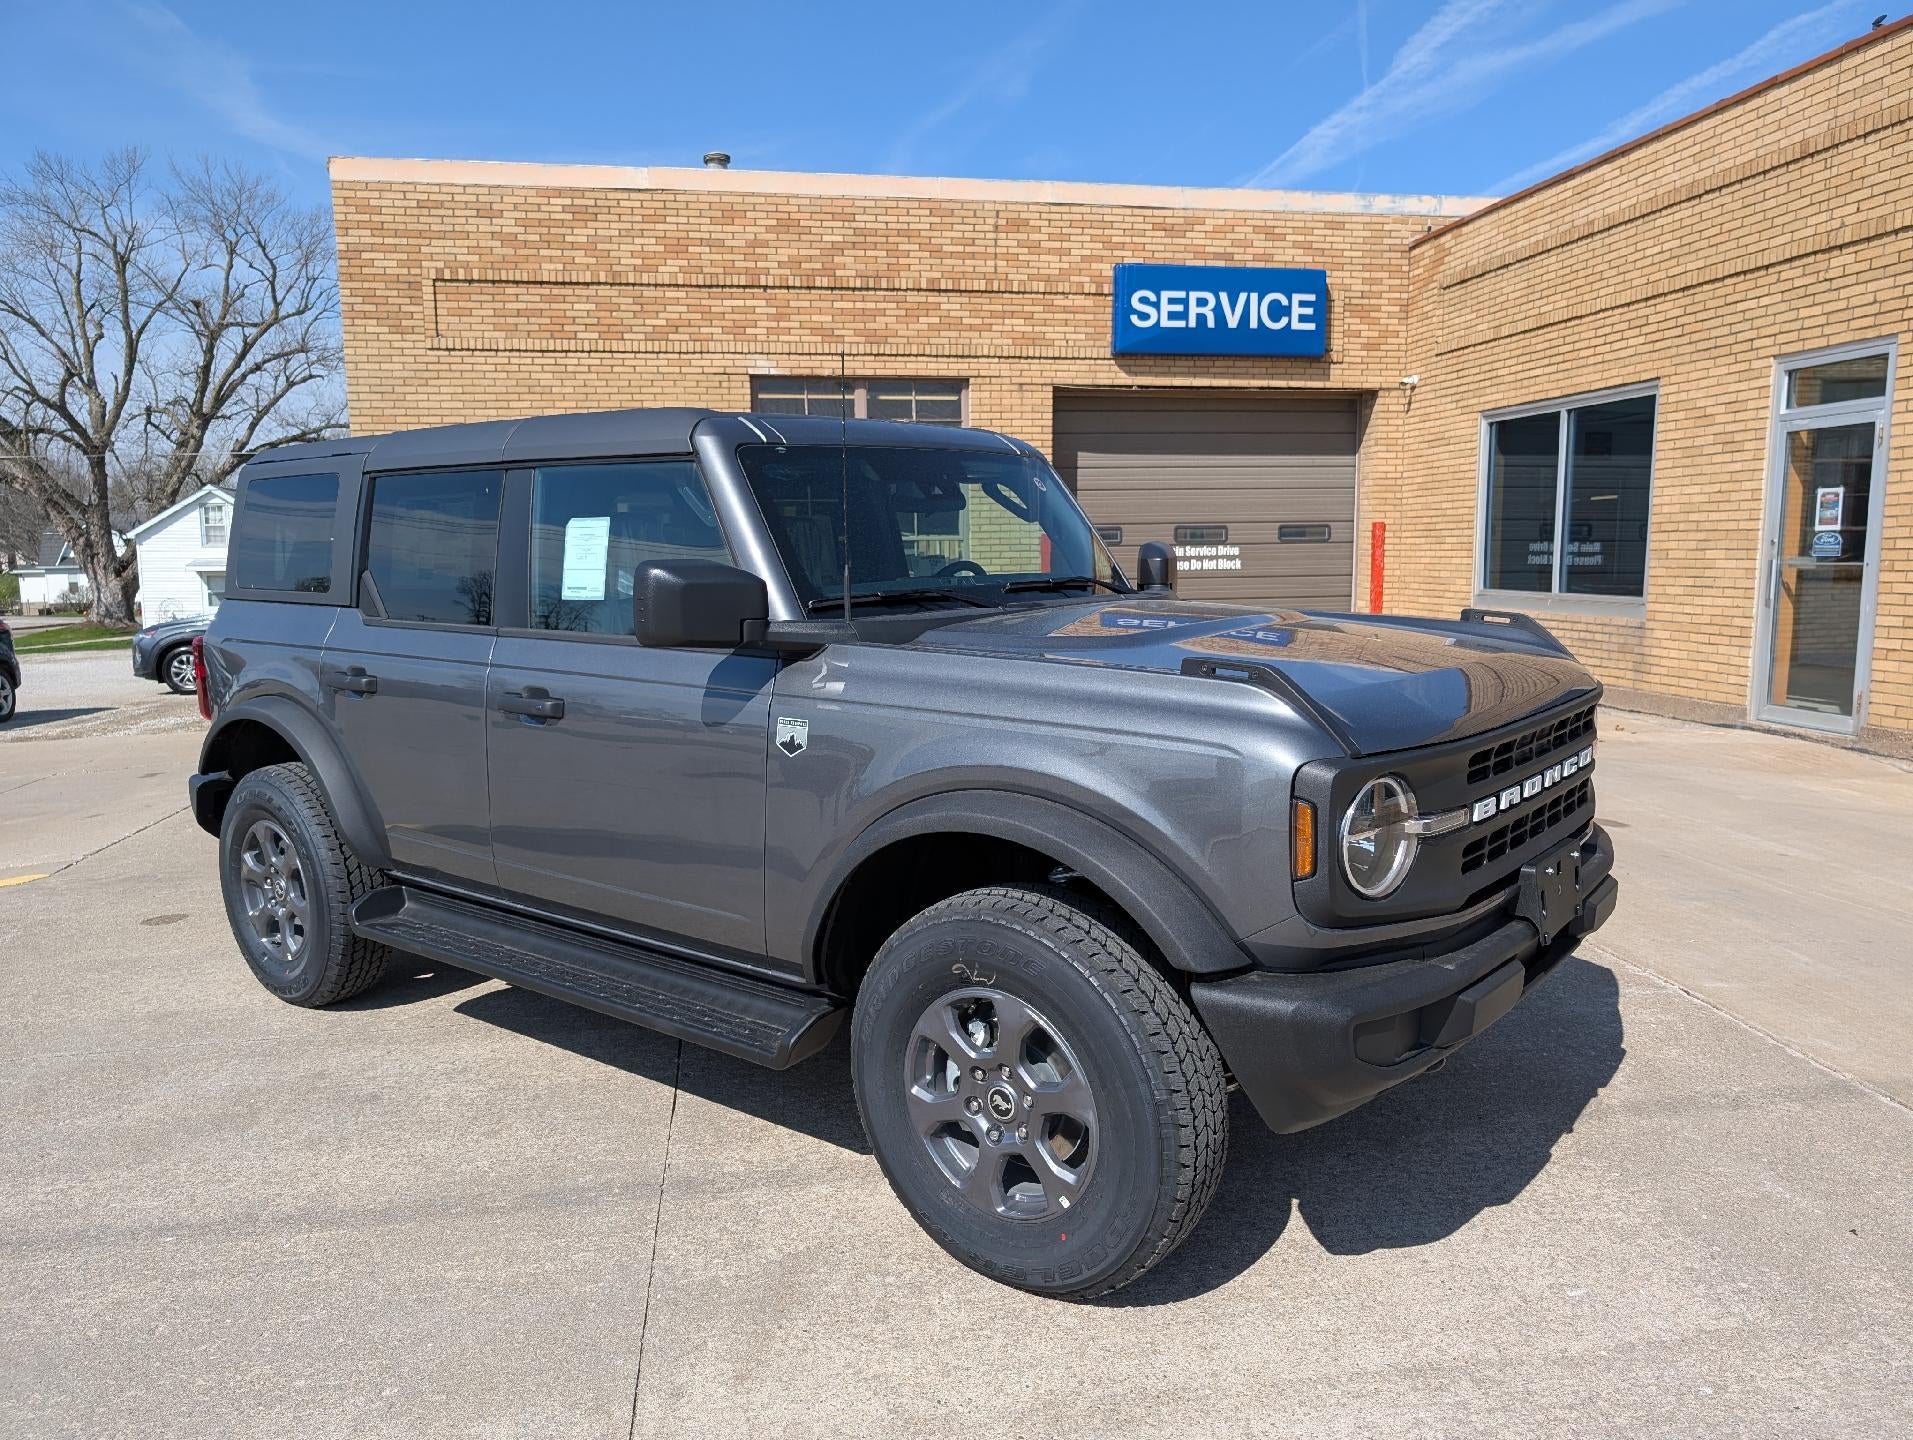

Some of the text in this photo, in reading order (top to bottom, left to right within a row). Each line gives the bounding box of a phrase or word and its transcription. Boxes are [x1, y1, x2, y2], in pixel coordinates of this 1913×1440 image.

[1130, 290, 1316, 330] SERVICE
[1186, 545, 1216, 556] Service
[1218, 545, 1240, 556] Drive
[1190, 559, 1201, 570] Do
[1203, 559, 1216, 570] Not
[1218, 558, 1241, 570] Block
[1473, 745, 1592, 822] BRONCO
